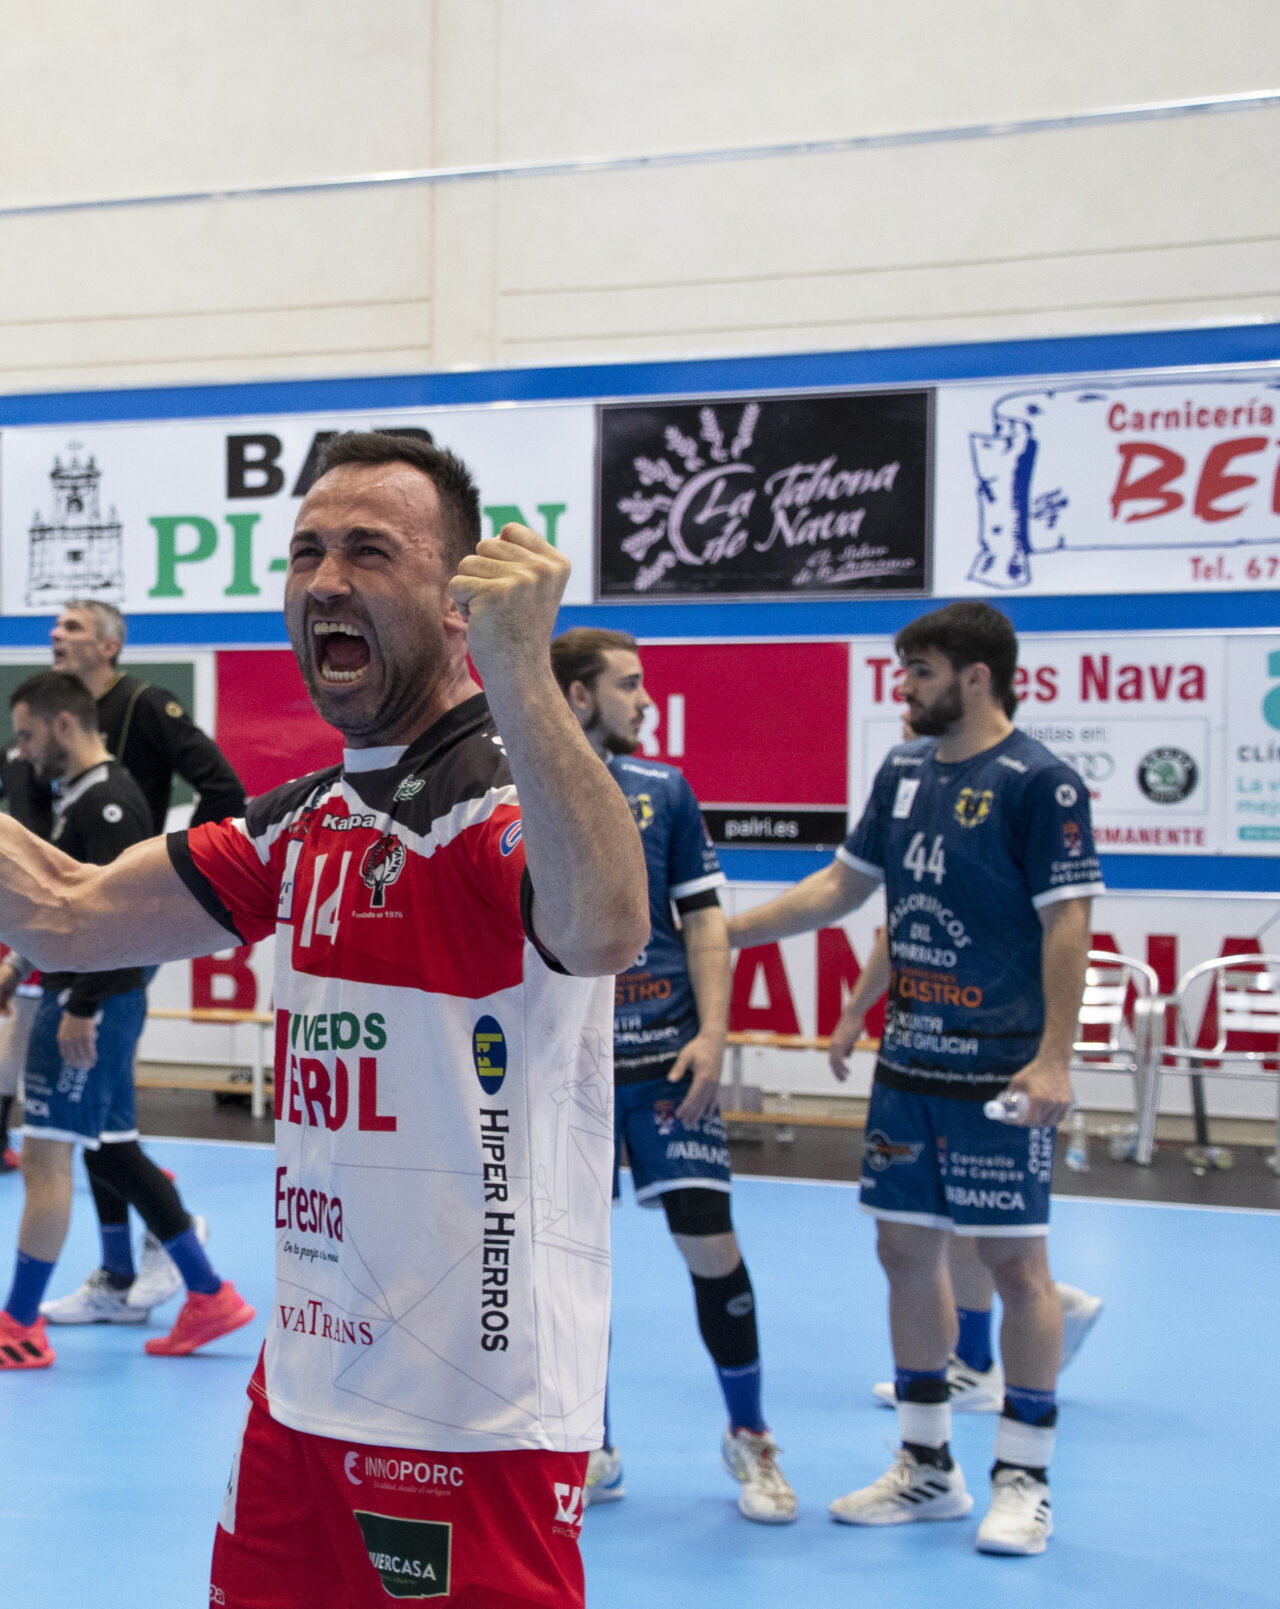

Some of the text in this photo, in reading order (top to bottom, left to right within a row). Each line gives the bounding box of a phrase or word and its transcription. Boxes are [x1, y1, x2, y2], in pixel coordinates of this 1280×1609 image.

[1108, 399, 1275, 432] Carnicería
[694, 453, 901, 525] La Tahona
[1111, 436, 1280, 524] BE
[753, 505, 866, 552] Nava
[1189, 556, 1233, 582] Tel.
[1080, 654, 1206, 702] Nava
[725, 817, 799, 840] palri.es
[902, 831, 947, 885] 44
[299, 850, 353, 948] 14
[479, 1107, 510, 1203] HIPER
[950, 1151, 1016, 1169] Concello
[480, 1212, 516, 1352] HIERROS
[364, 1456, 465, 1488] INNOPORC
